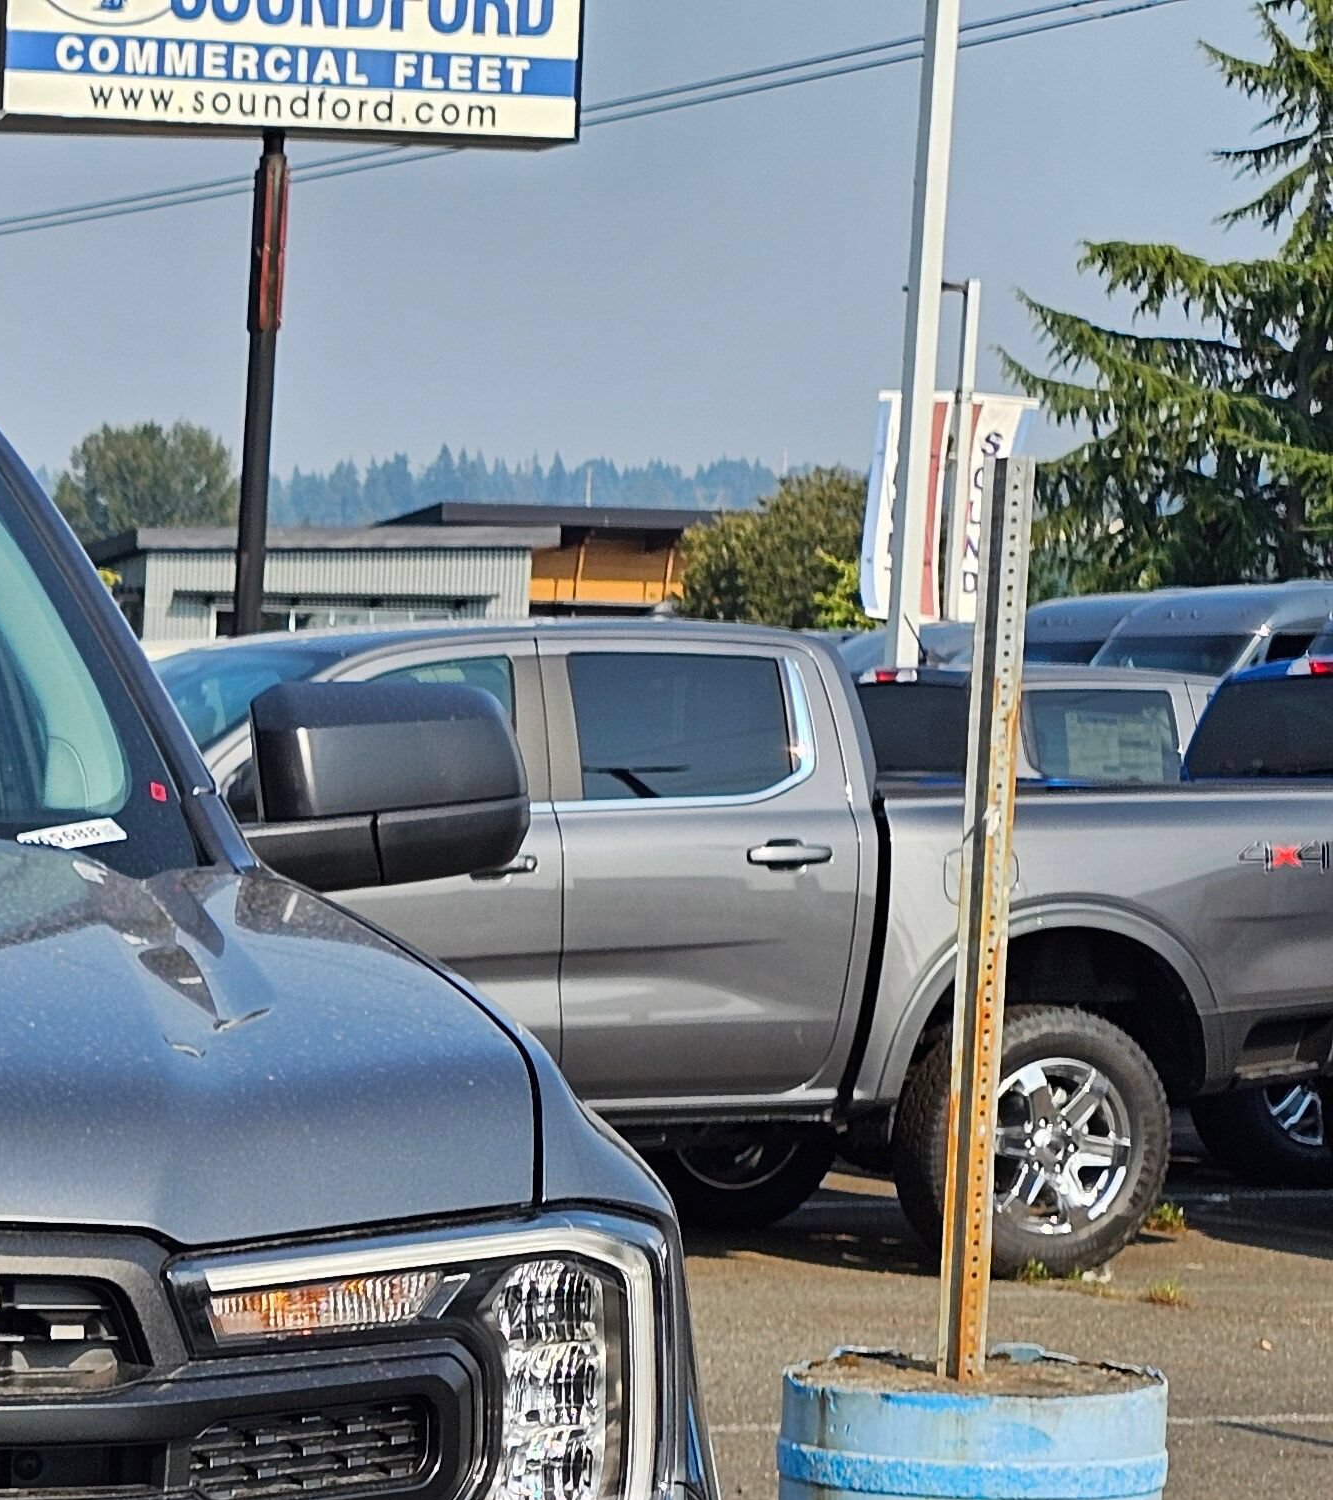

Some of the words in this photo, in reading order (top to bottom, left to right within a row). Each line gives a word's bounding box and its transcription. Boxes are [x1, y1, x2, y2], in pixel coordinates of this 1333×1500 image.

[55, 35, 368, 86] COMMERCIAL
[394, 52, 531, 94] FLEET
[89, 85, 496, 128] www.soundford.com
